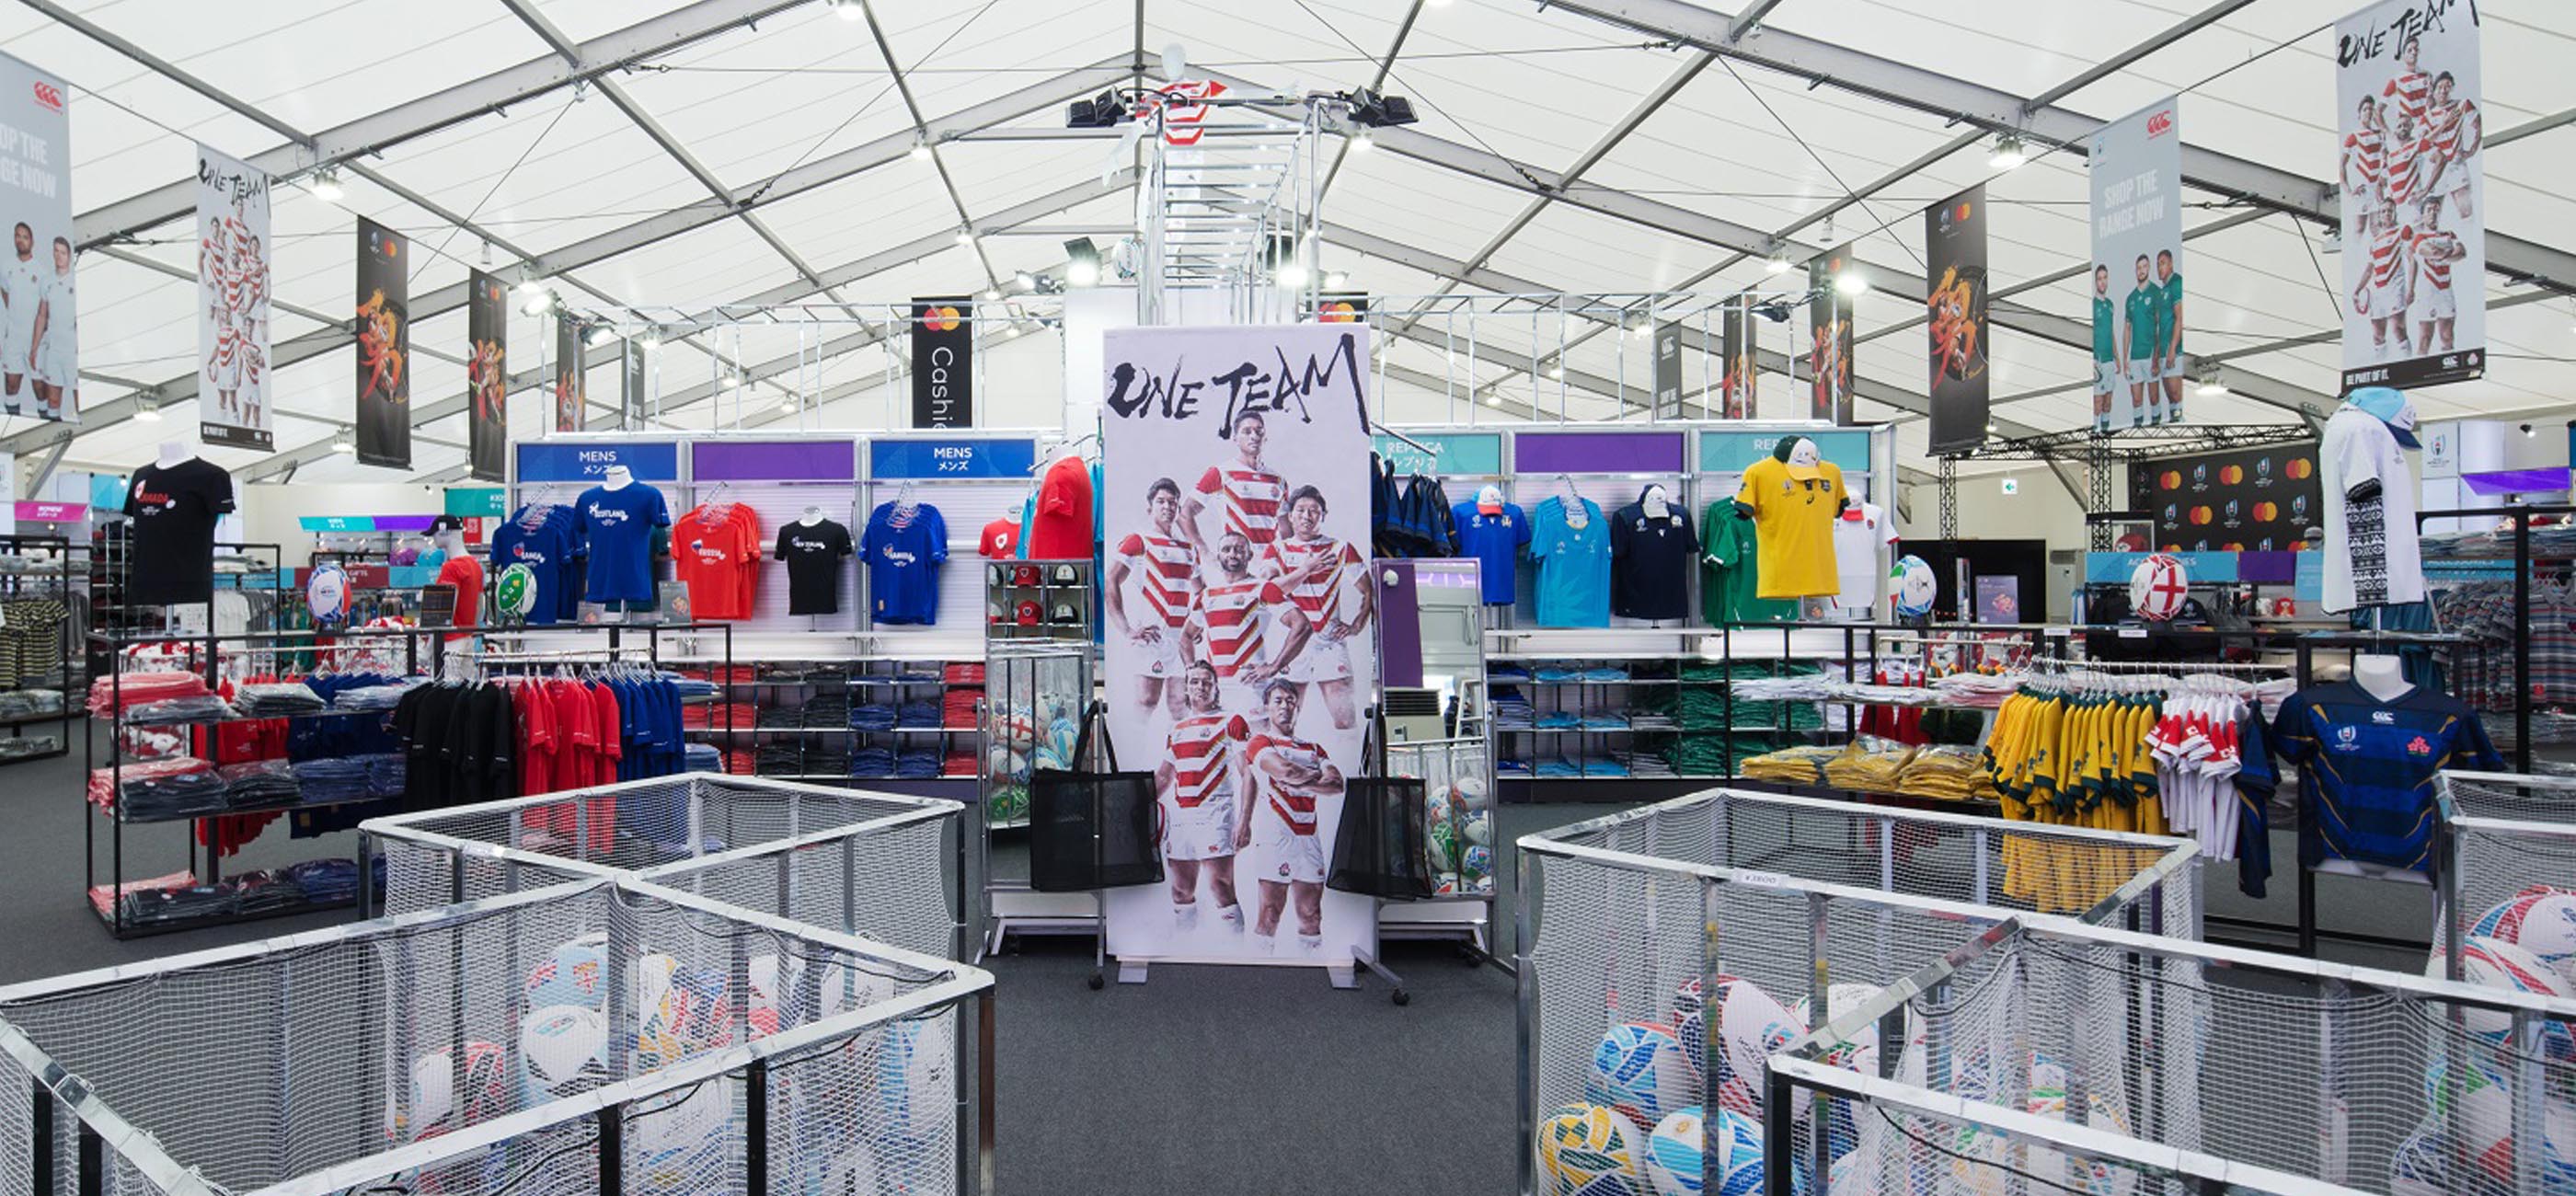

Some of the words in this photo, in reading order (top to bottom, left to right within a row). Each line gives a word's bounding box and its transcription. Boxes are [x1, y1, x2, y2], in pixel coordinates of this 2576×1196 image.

[2338, 18, 2386, 68] ONE
[19, 131, 47, 164] THE
[22, 164, 56, 199] NOW
[199, 158, 226, 191] ONE
[229, 172, 271, 220] TEAM
[2104, 178, 2134, 210] SHOP
[2135, 168, 2157, 198] THE
[2099, 205, 2135, 239] RANGE
[2135, 194, 2165, 227] NOW
[1108, 354, 1205, 420] ONE
[1212, 332, 1371, 440] TEAM
[579, 451, 617, 462] MENS
[934, 447, 972, 459] MENS
[938, 461, 969, 471] メンズ
[593, 509, 627, 519] SCOTLAND
